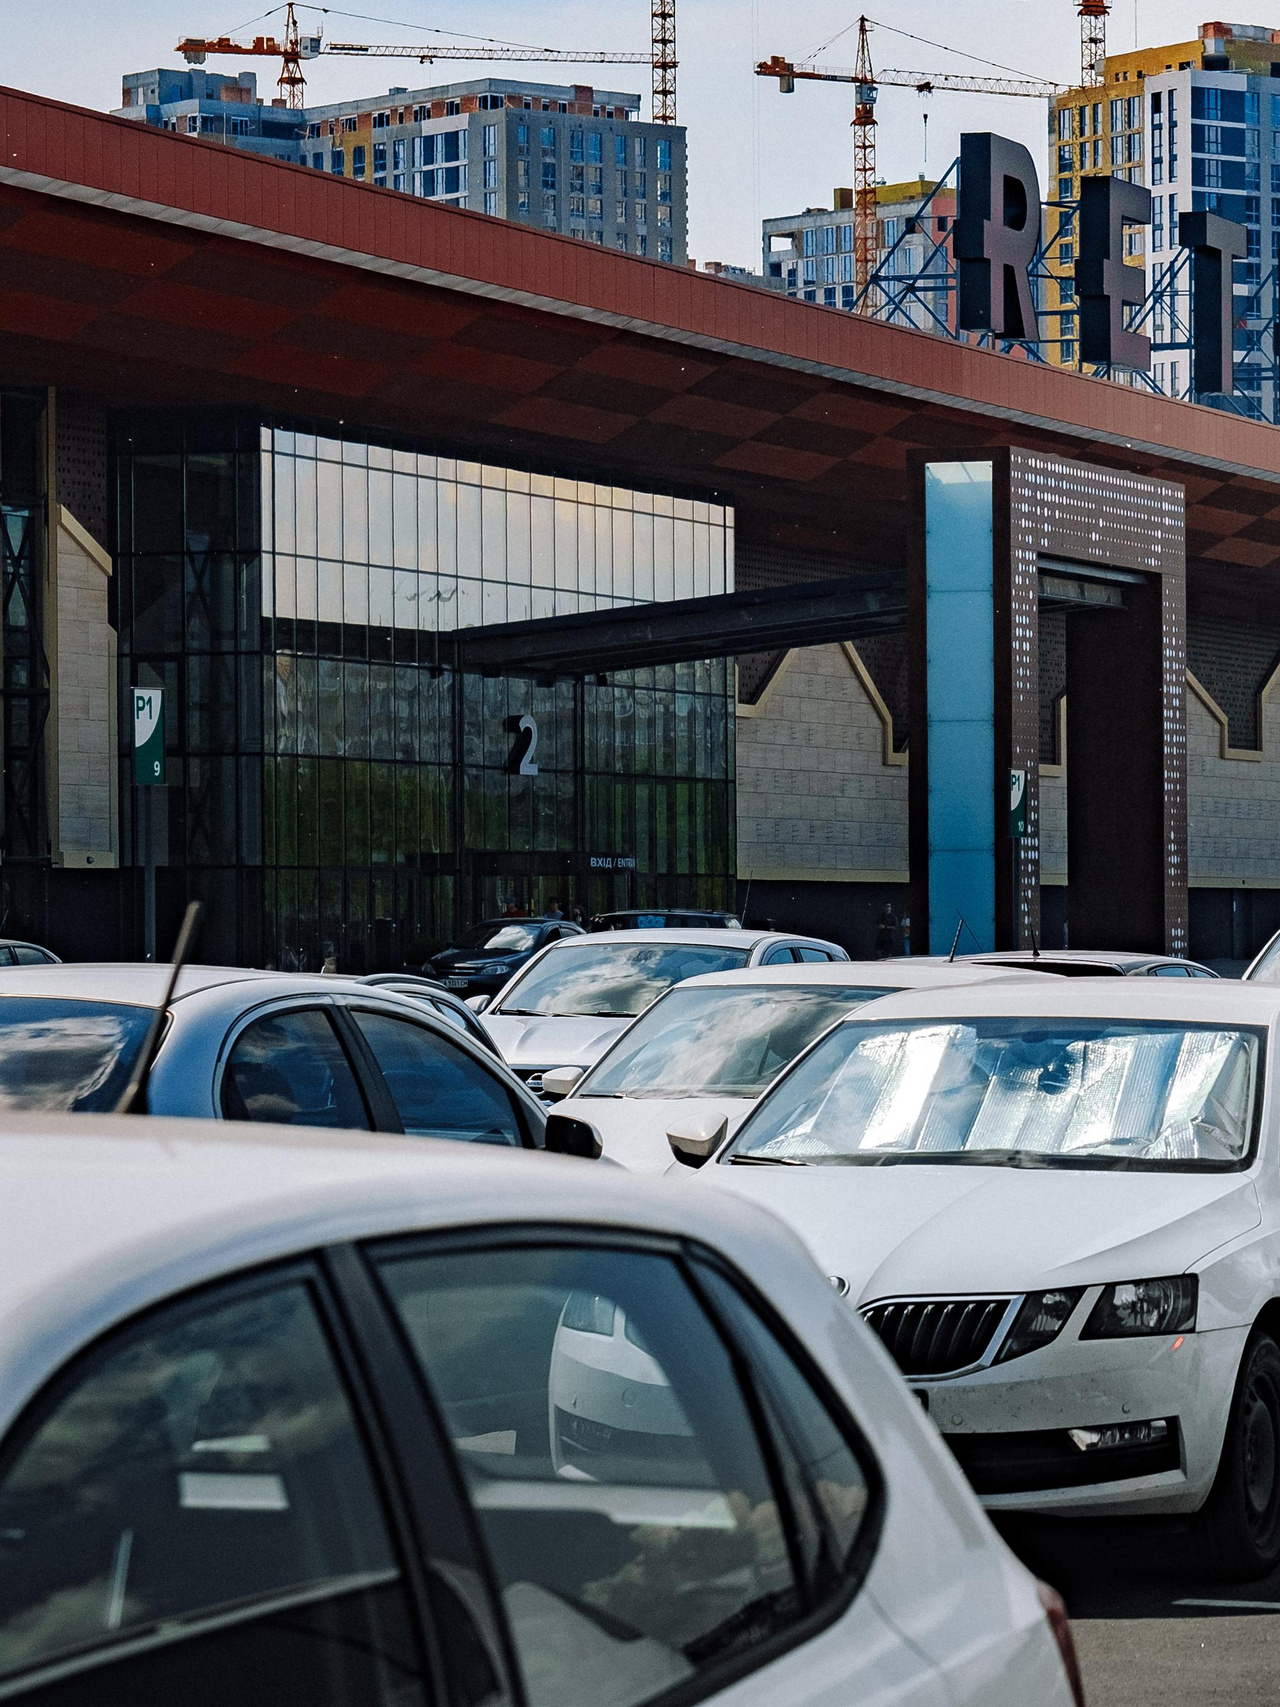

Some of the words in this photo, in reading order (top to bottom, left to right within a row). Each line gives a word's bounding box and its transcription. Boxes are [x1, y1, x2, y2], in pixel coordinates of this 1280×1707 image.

[135, 695, 153, 720] P1
[510, 714, 539, 776] 2
[153, 761, 161, 776] 9
[1010, 774, 1021, 791] P1
[1018, 821, 1025, 832] 10
[590, 857, 613, 869] ВХІД
